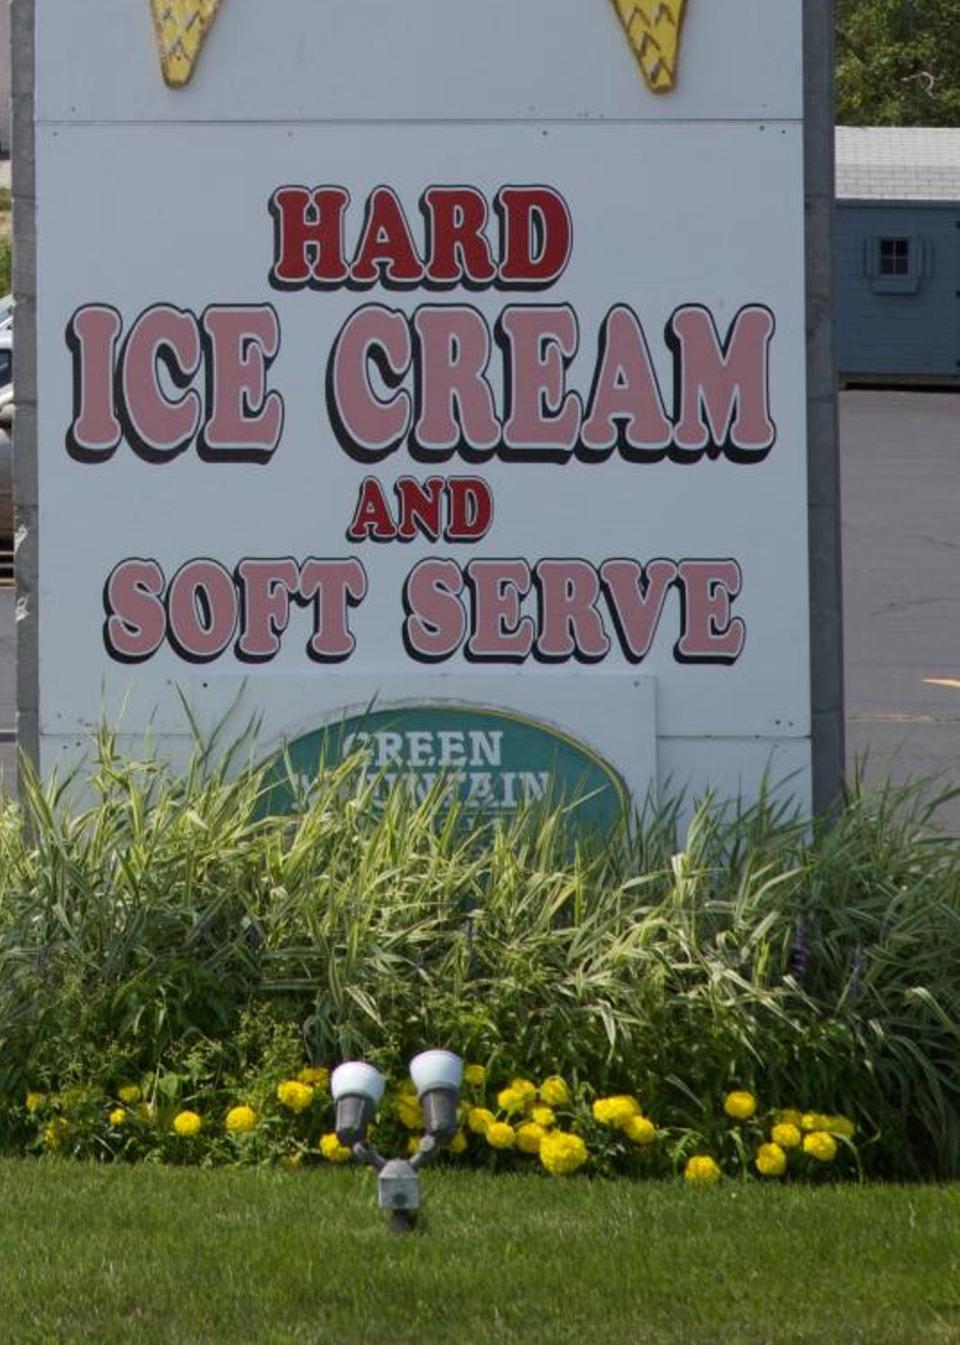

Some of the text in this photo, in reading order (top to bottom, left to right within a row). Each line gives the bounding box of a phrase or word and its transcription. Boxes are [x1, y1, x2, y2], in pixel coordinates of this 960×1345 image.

[268, 184, 573, 291] HARD
[65, 302, 777, 464] ICE CREAM
[345, 476, 493, 543] AND
[103, 557, 745, 665] SOFT SERVE
[293, 771, 551, 808] UNAIN
[343, 731, 504, 766] GREEN
